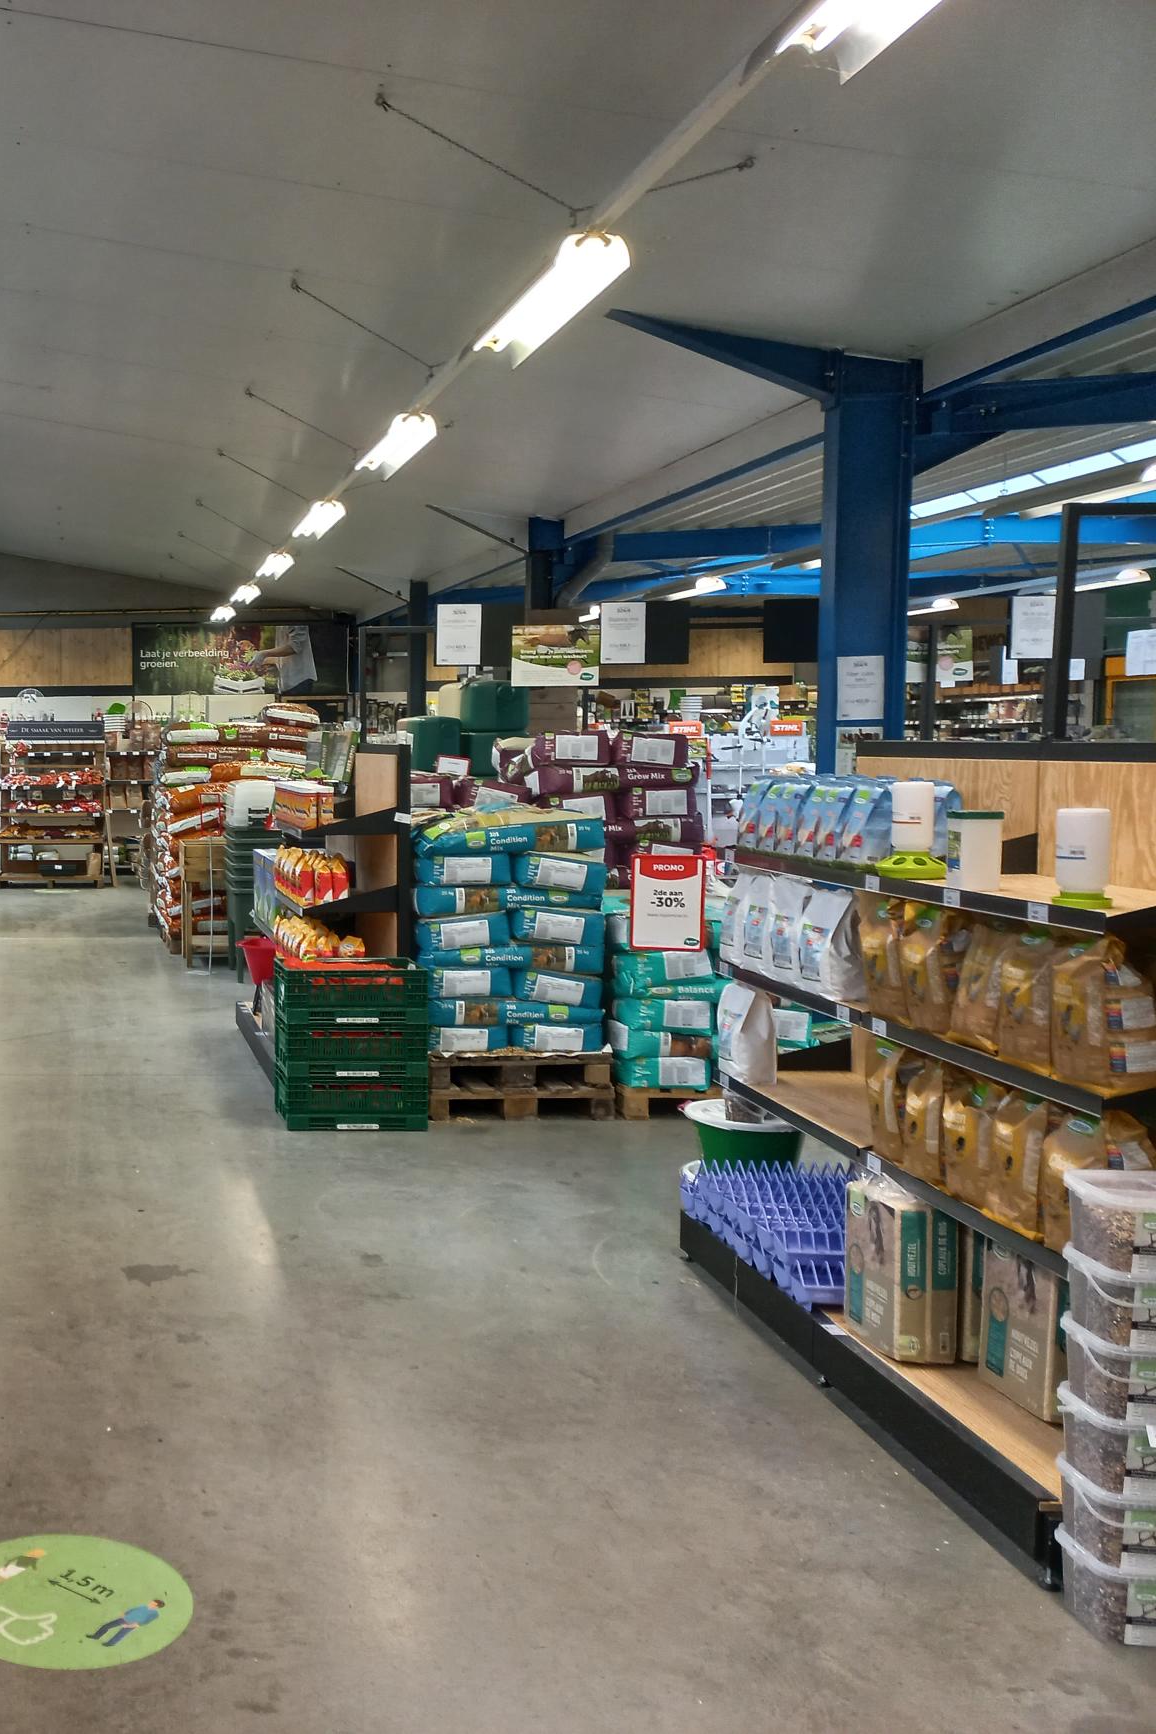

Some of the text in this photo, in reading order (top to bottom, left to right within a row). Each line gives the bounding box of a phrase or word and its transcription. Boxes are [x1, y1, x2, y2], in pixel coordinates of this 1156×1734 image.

[140, 648, 230, 659] Laat je verbeelding
[140, 660, 180, 670] groeien.
[773, 724, 801, 732] STIHL
[650, 772, 665, 780] Mix
[608, 824, 623, 832] Mix
[490, 836, 528, 846] Condition
[506, 894, 545, 902] Condition
[650, 897, 686, 908] -30%
[677, 985, 716, 994] Balance
[506, 1011, 545, 1019] Condition
